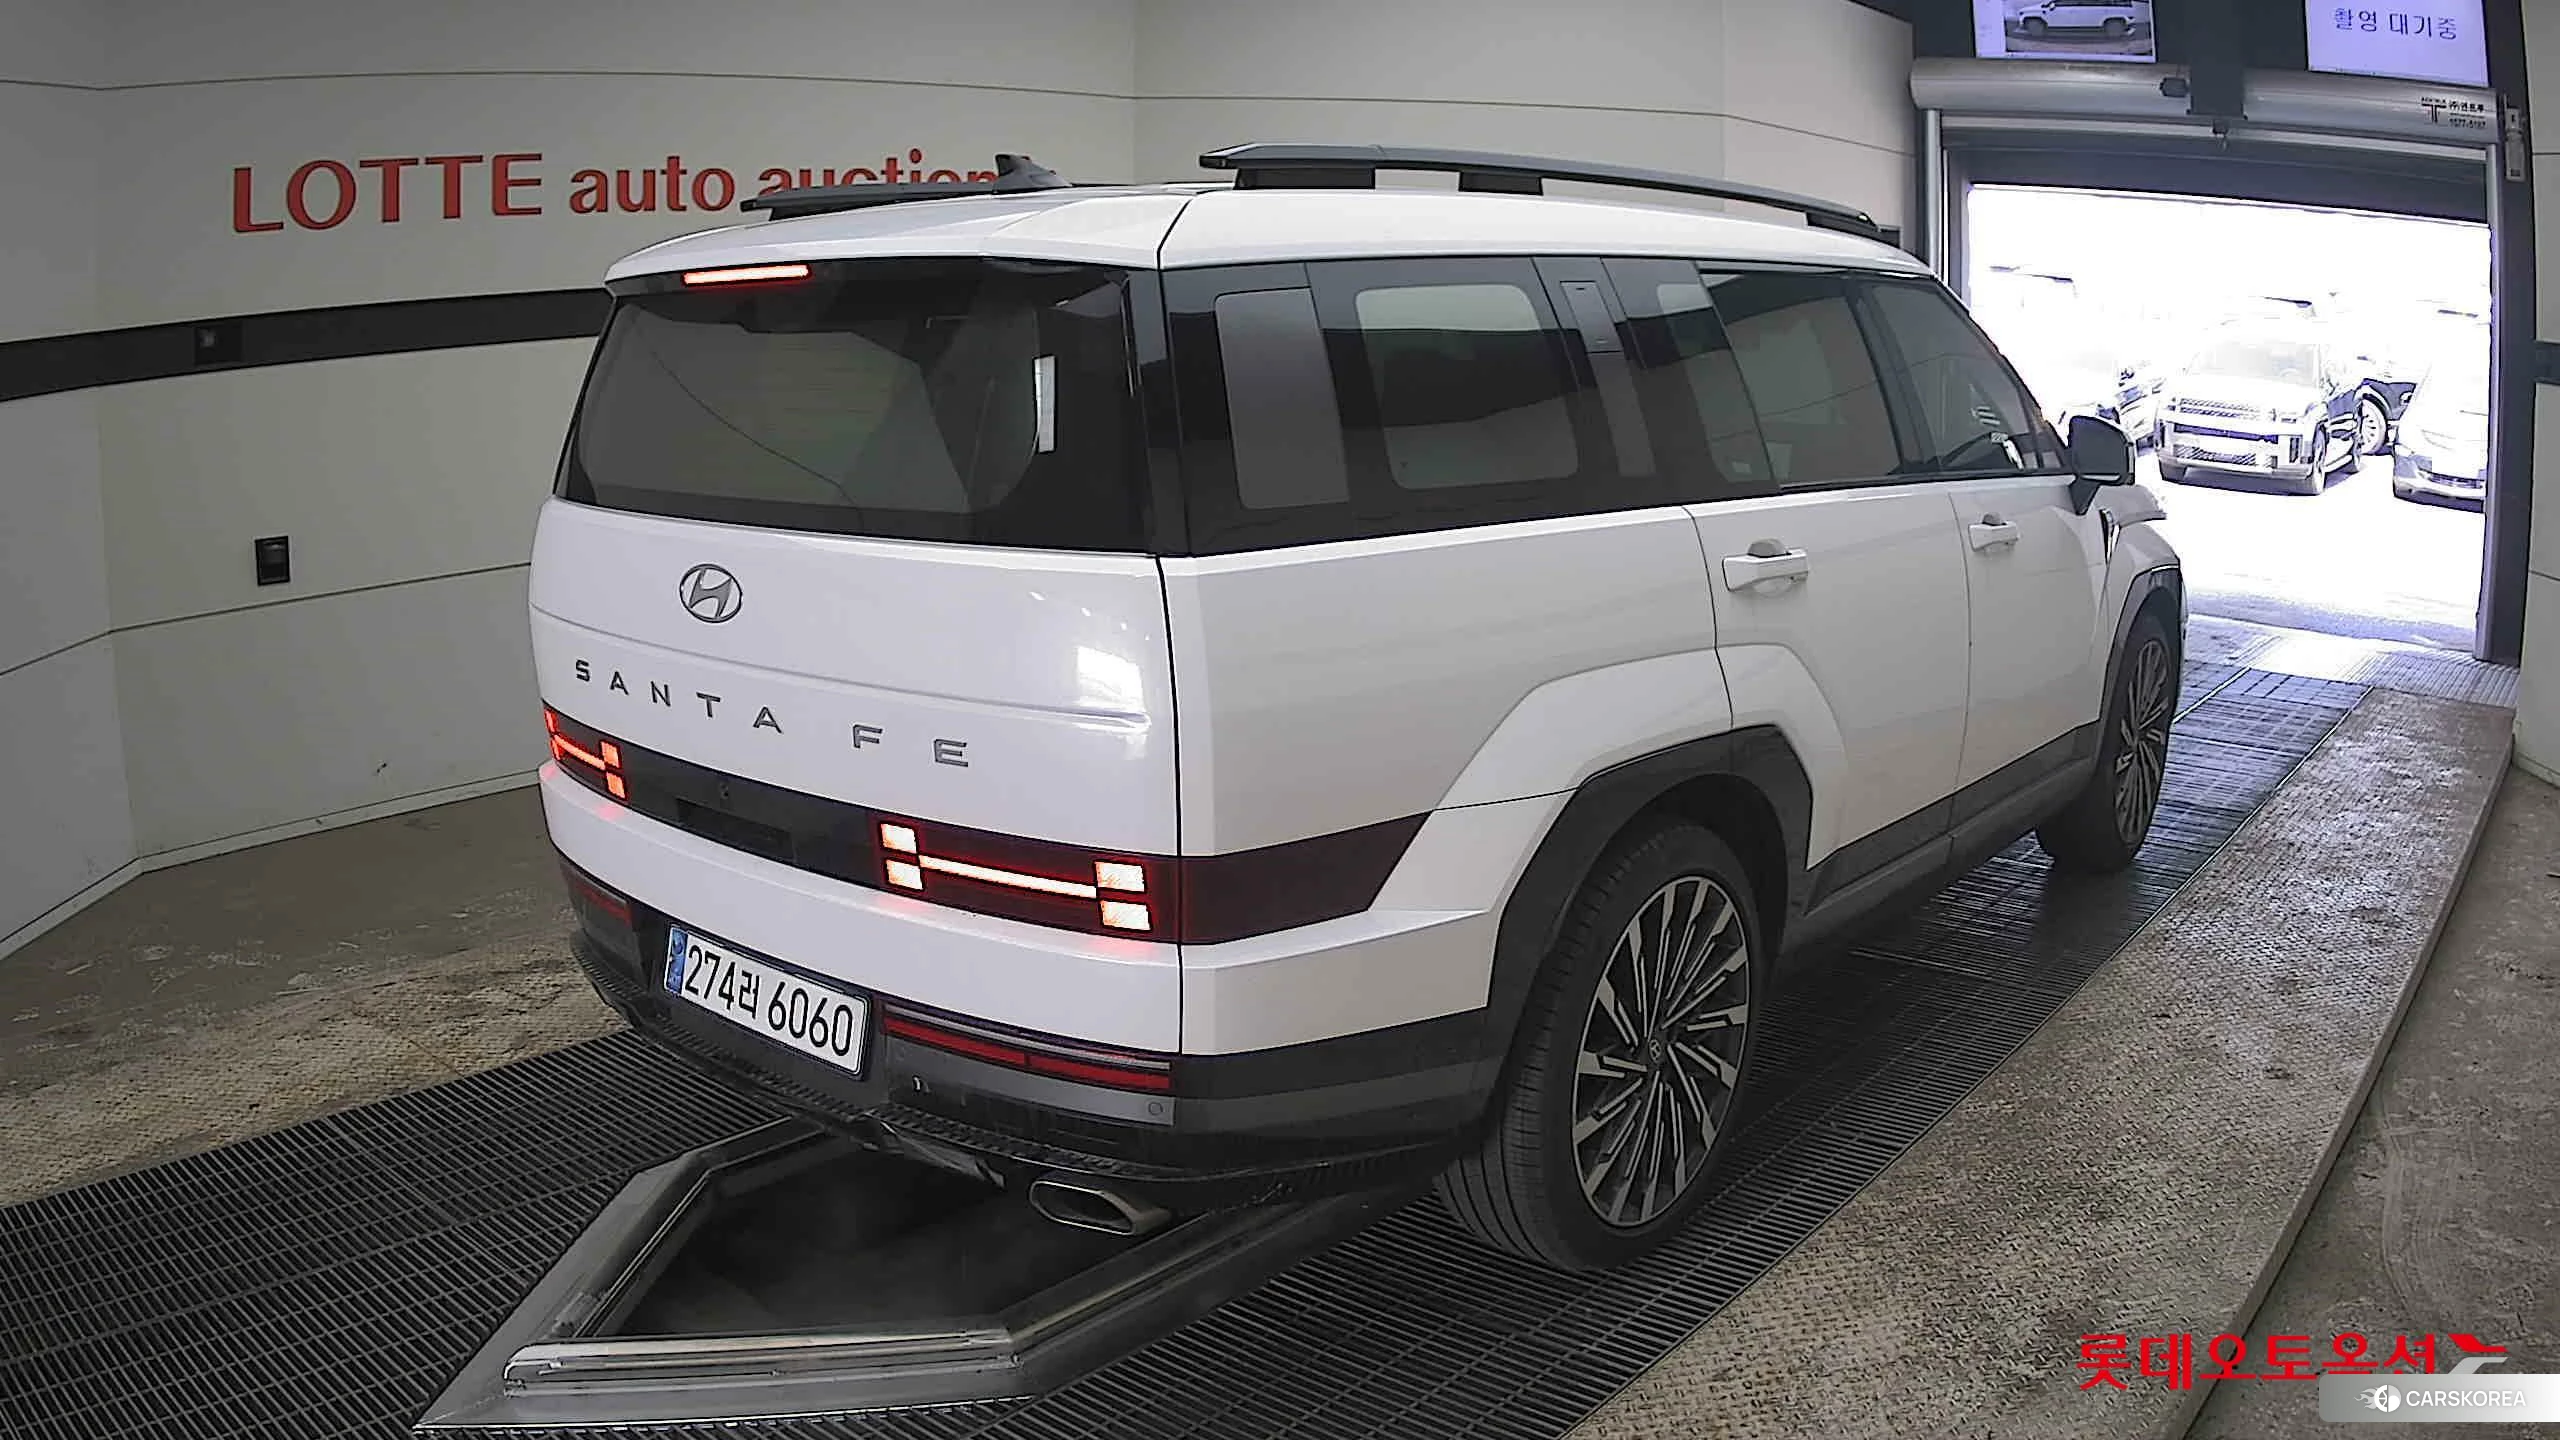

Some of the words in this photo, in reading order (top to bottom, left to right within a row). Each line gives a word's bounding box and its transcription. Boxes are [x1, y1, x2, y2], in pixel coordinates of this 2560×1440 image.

[2335, 7, 2377, 32] 촬영
[2388, 13, 2457, 40] 대기중
[233, 152, 543, 233] LOTTE
[569, 155, 735, 213] auto
[574, 658, 784, 734] SANTA
[851, 723, 969, 768] FE
[684, 944, 760, 1020] 274러
[767, 980, 854, 1057] 6060
